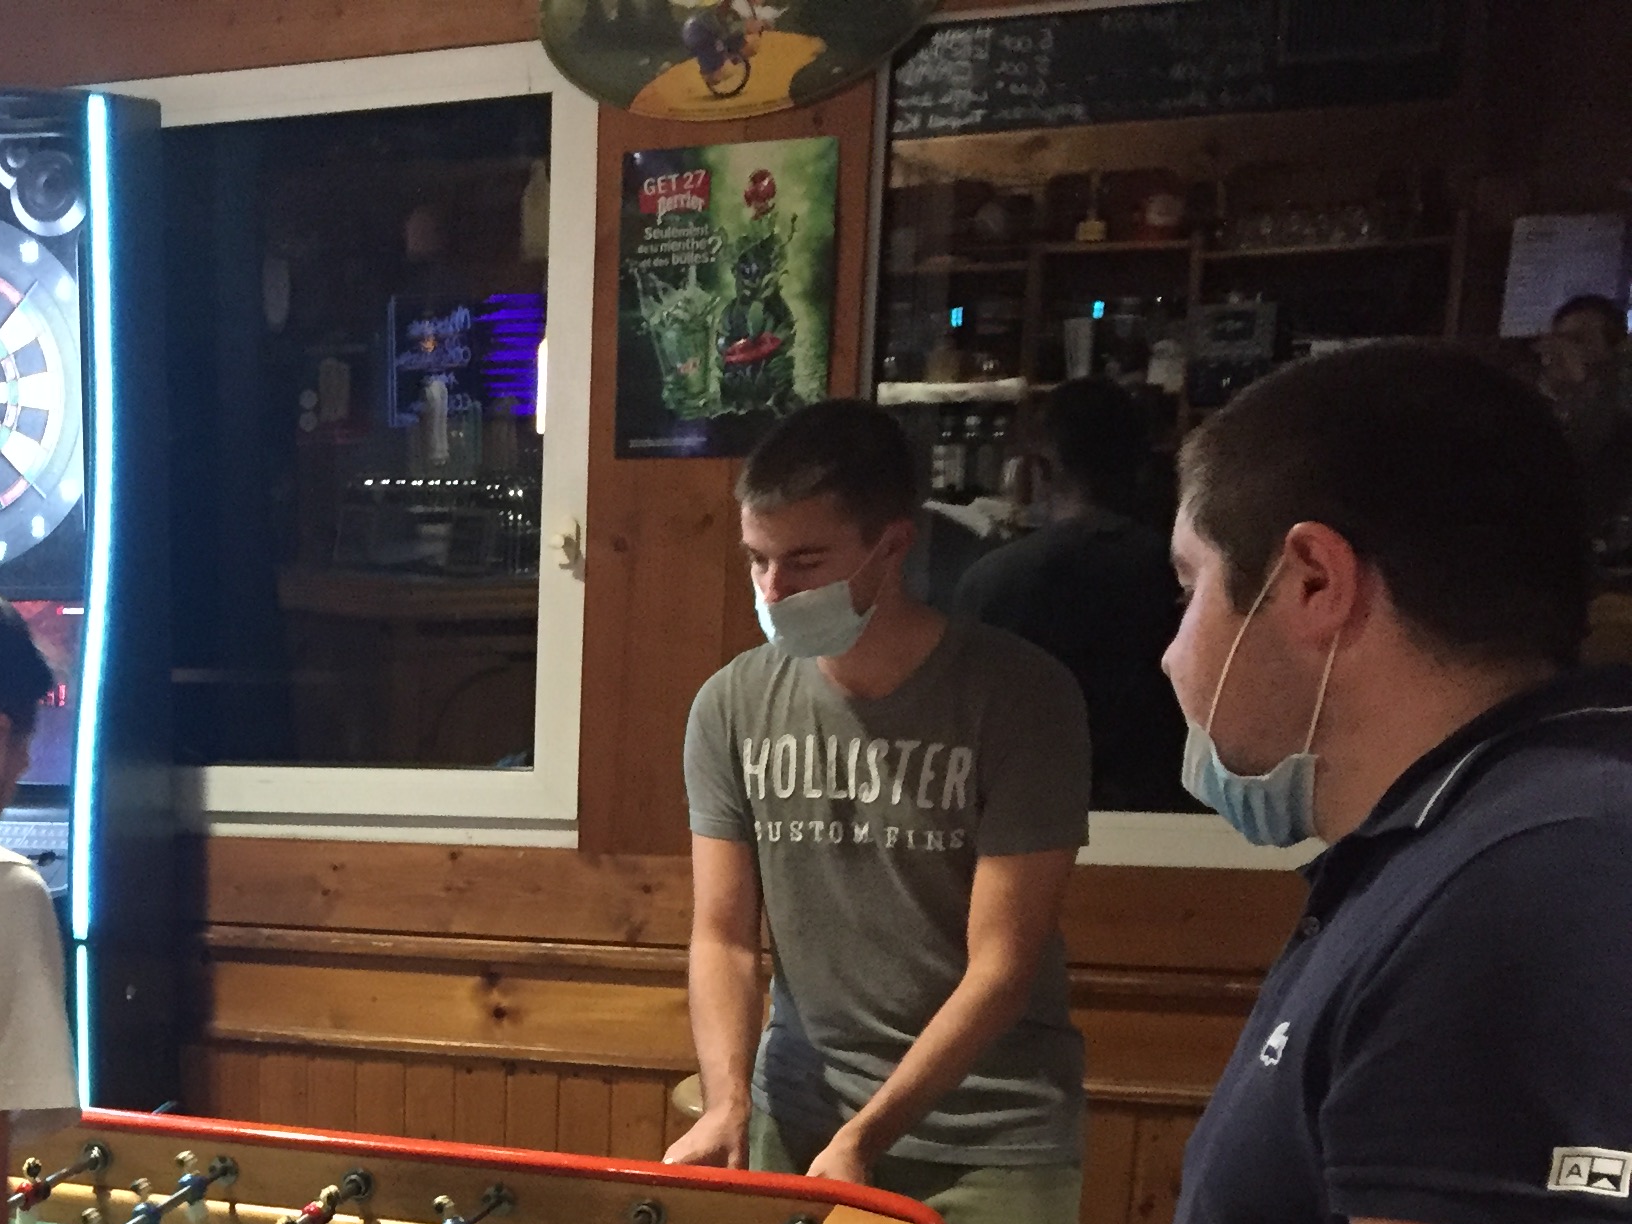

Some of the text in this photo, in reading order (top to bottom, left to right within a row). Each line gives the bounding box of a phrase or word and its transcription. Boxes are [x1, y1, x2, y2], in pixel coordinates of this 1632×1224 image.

[643, 168, 707, 196] GET 27
[644, 223, 709, 240] Seulement
[660, 238, 707, 253] menthe
[742, 733, 974, 810] HOLLISTER
[884, 826, 966, 851] FINS
